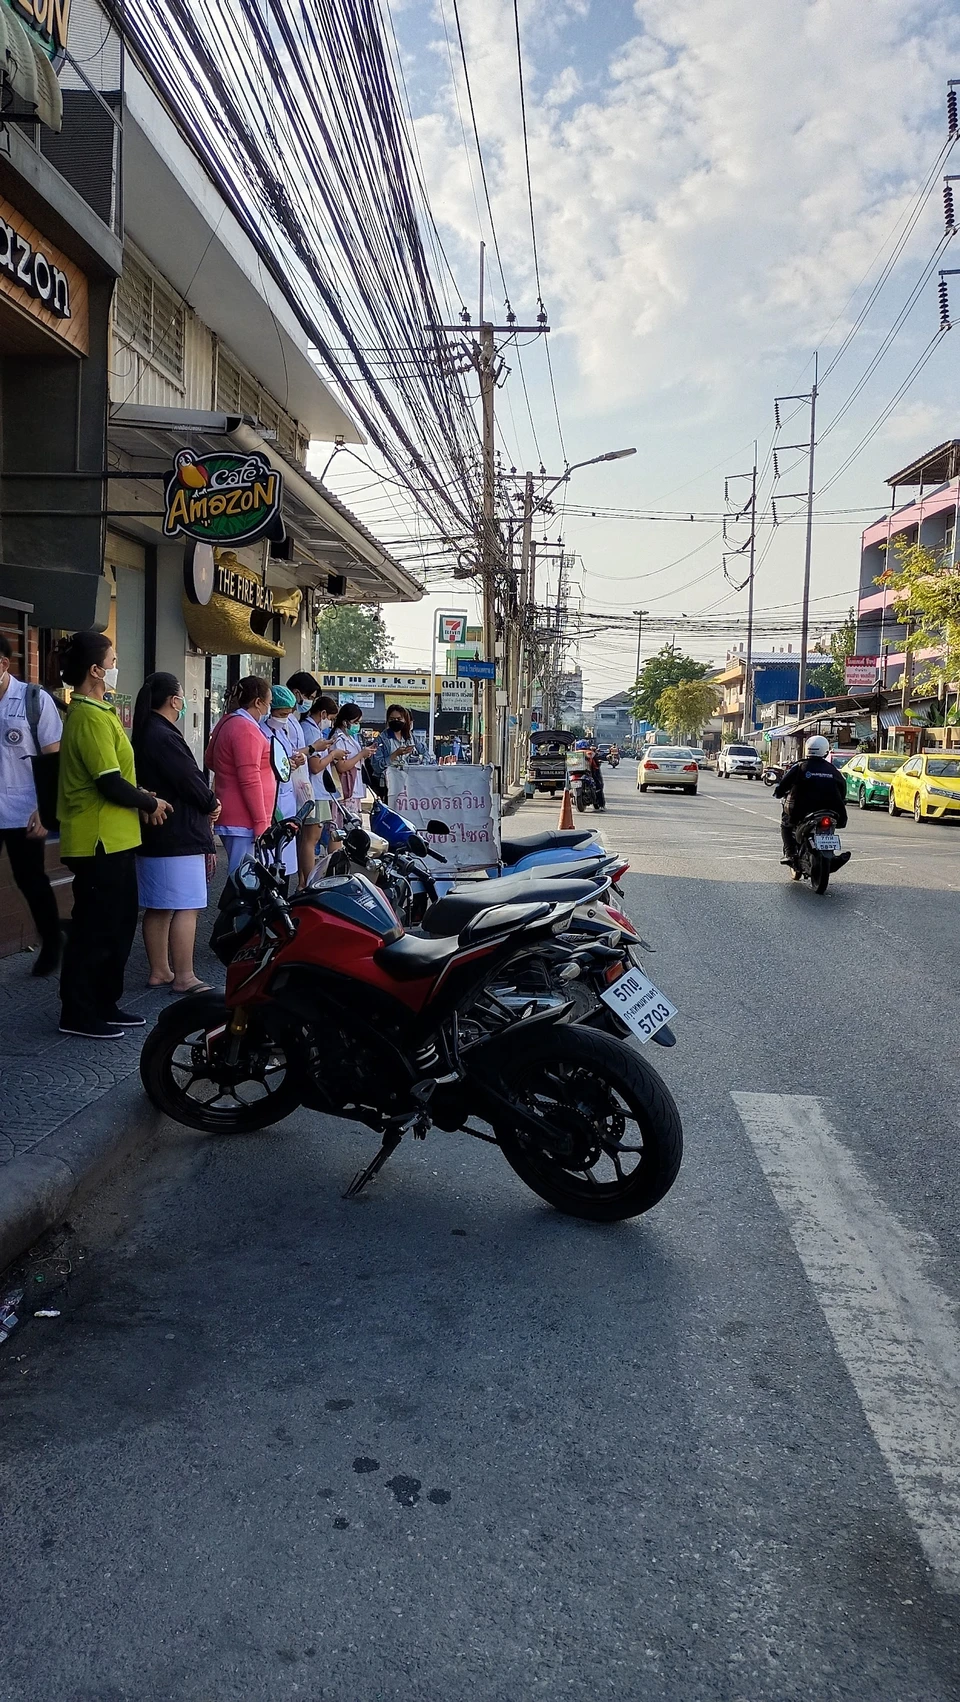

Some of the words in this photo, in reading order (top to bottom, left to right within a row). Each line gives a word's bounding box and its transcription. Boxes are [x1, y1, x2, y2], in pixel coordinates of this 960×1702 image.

[218, 565, 235, 597] THE
[237, 575, 255, 605] FIRE
[255, 583, 275, 614] BEAR
[323, 675, 346, 687] MT
[395, 785, 486, 811] ที่จอดรถวิน
[612, 976, 643, 1003] 5กญ
[623, 987, 659, 1021] กรุงเทพมหานคร
[637, 1003, 670, 1035] 5703
